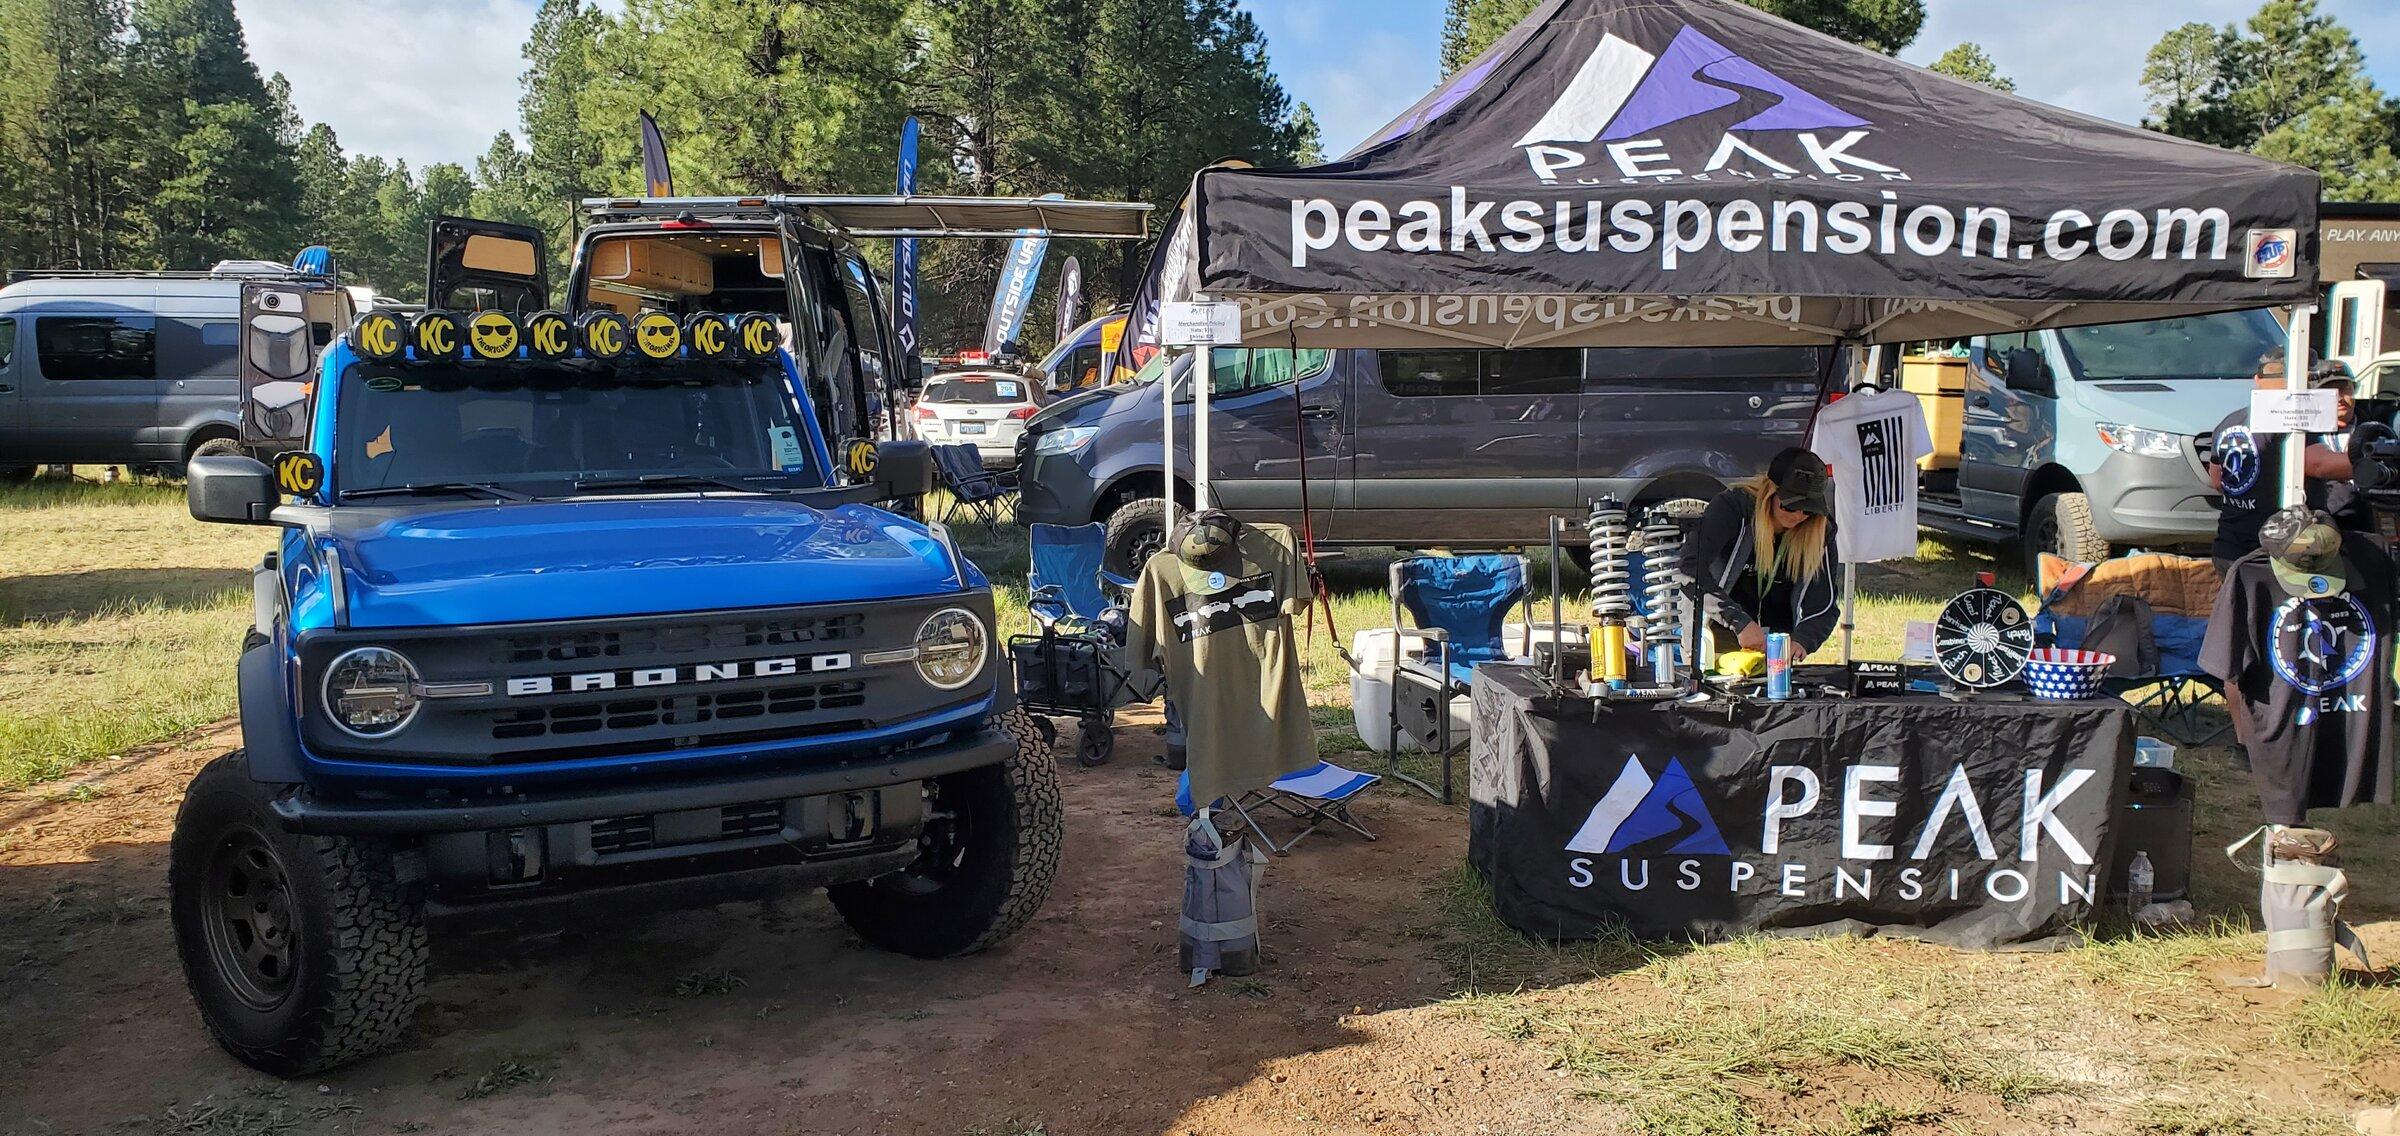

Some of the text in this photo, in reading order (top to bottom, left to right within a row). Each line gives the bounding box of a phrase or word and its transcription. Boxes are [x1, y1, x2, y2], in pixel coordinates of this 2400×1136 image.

[1525, 131, 1902, 180] PEAK
[1291, 186, 2230, 271] peaksuspension.com
[2327, 228, 2367, 242] PLAY.
[901, 229, 914, 319] OUTSI
[996, 266, 1028, 344] OUTSIDE
[362, 316, 397, 356] KC
[420, 316, 455, 356] KC
[533, 317, 568, 356] KC
[589, 317, 622, 356] KC
[694, 318, 726, 356] KC
[744, 318, 774, 356] KC
[280, 455, 315, 493] KC
[850, 441, 875, 475] KC
[2007, 629, 2032, 641] Patch
[507, 653, 851, 696] BRONCO
[1870, 664, 1897, 672] PEAK
[1876, 681, 1900, 689] PEAK
[2319, 694, 2368, 713] EAK
[1762, 762, 2097, 866] PEAK
[1568, 857, 2097, 908] SUSPENSION
